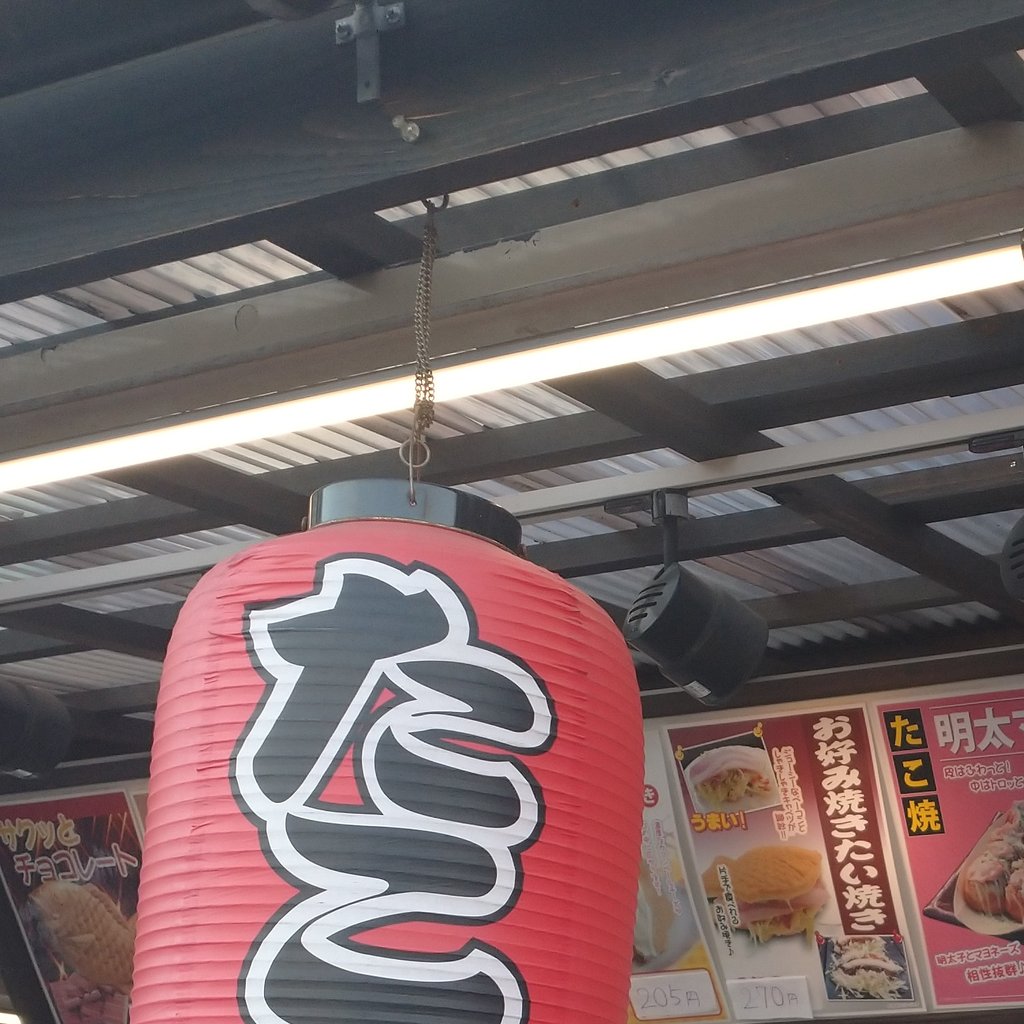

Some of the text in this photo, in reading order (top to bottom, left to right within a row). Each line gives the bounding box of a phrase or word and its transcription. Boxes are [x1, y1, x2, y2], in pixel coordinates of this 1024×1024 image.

[890, 714, 942, 833] たこ焼
[813, 716, 887, 932] お好み焼きたい焼き
[14, 842, 138, 886] チョコレート
[935, 941, 1022, 967] 明太子とマヨネーズ
[636, 985, 701, 1010] 205円
